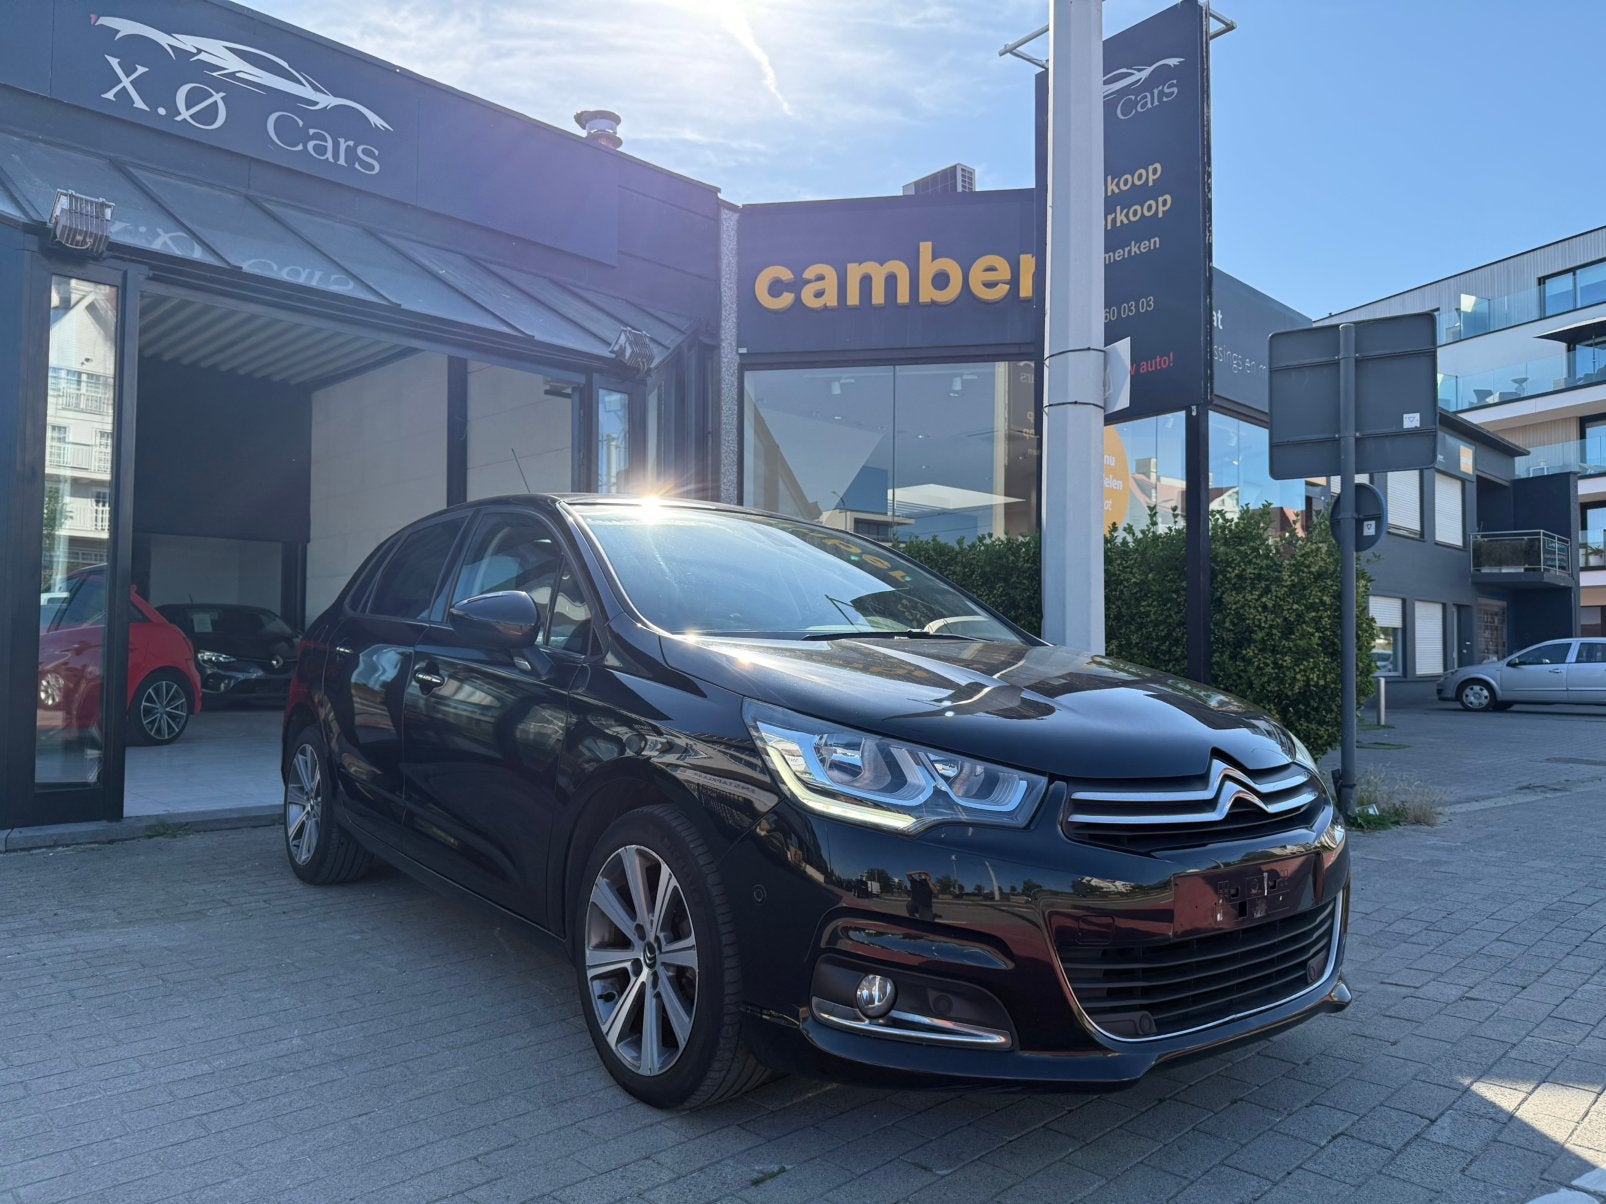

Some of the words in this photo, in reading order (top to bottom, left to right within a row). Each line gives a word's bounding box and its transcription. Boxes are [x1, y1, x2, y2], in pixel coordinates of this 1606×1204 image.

[1116, 79, 1178, 120] Cars
[266, 111, 381, 175] Cars
[1103, 162, 1162, 197] koop
[1103, 194, 1172, 230] rkoop
[755, 241, 1036, 311] camber
[1121, 301, 1136, 318] 03
[1139, 296, 1154, 313] 03
[1140, 351, 1174, 373] auto!
